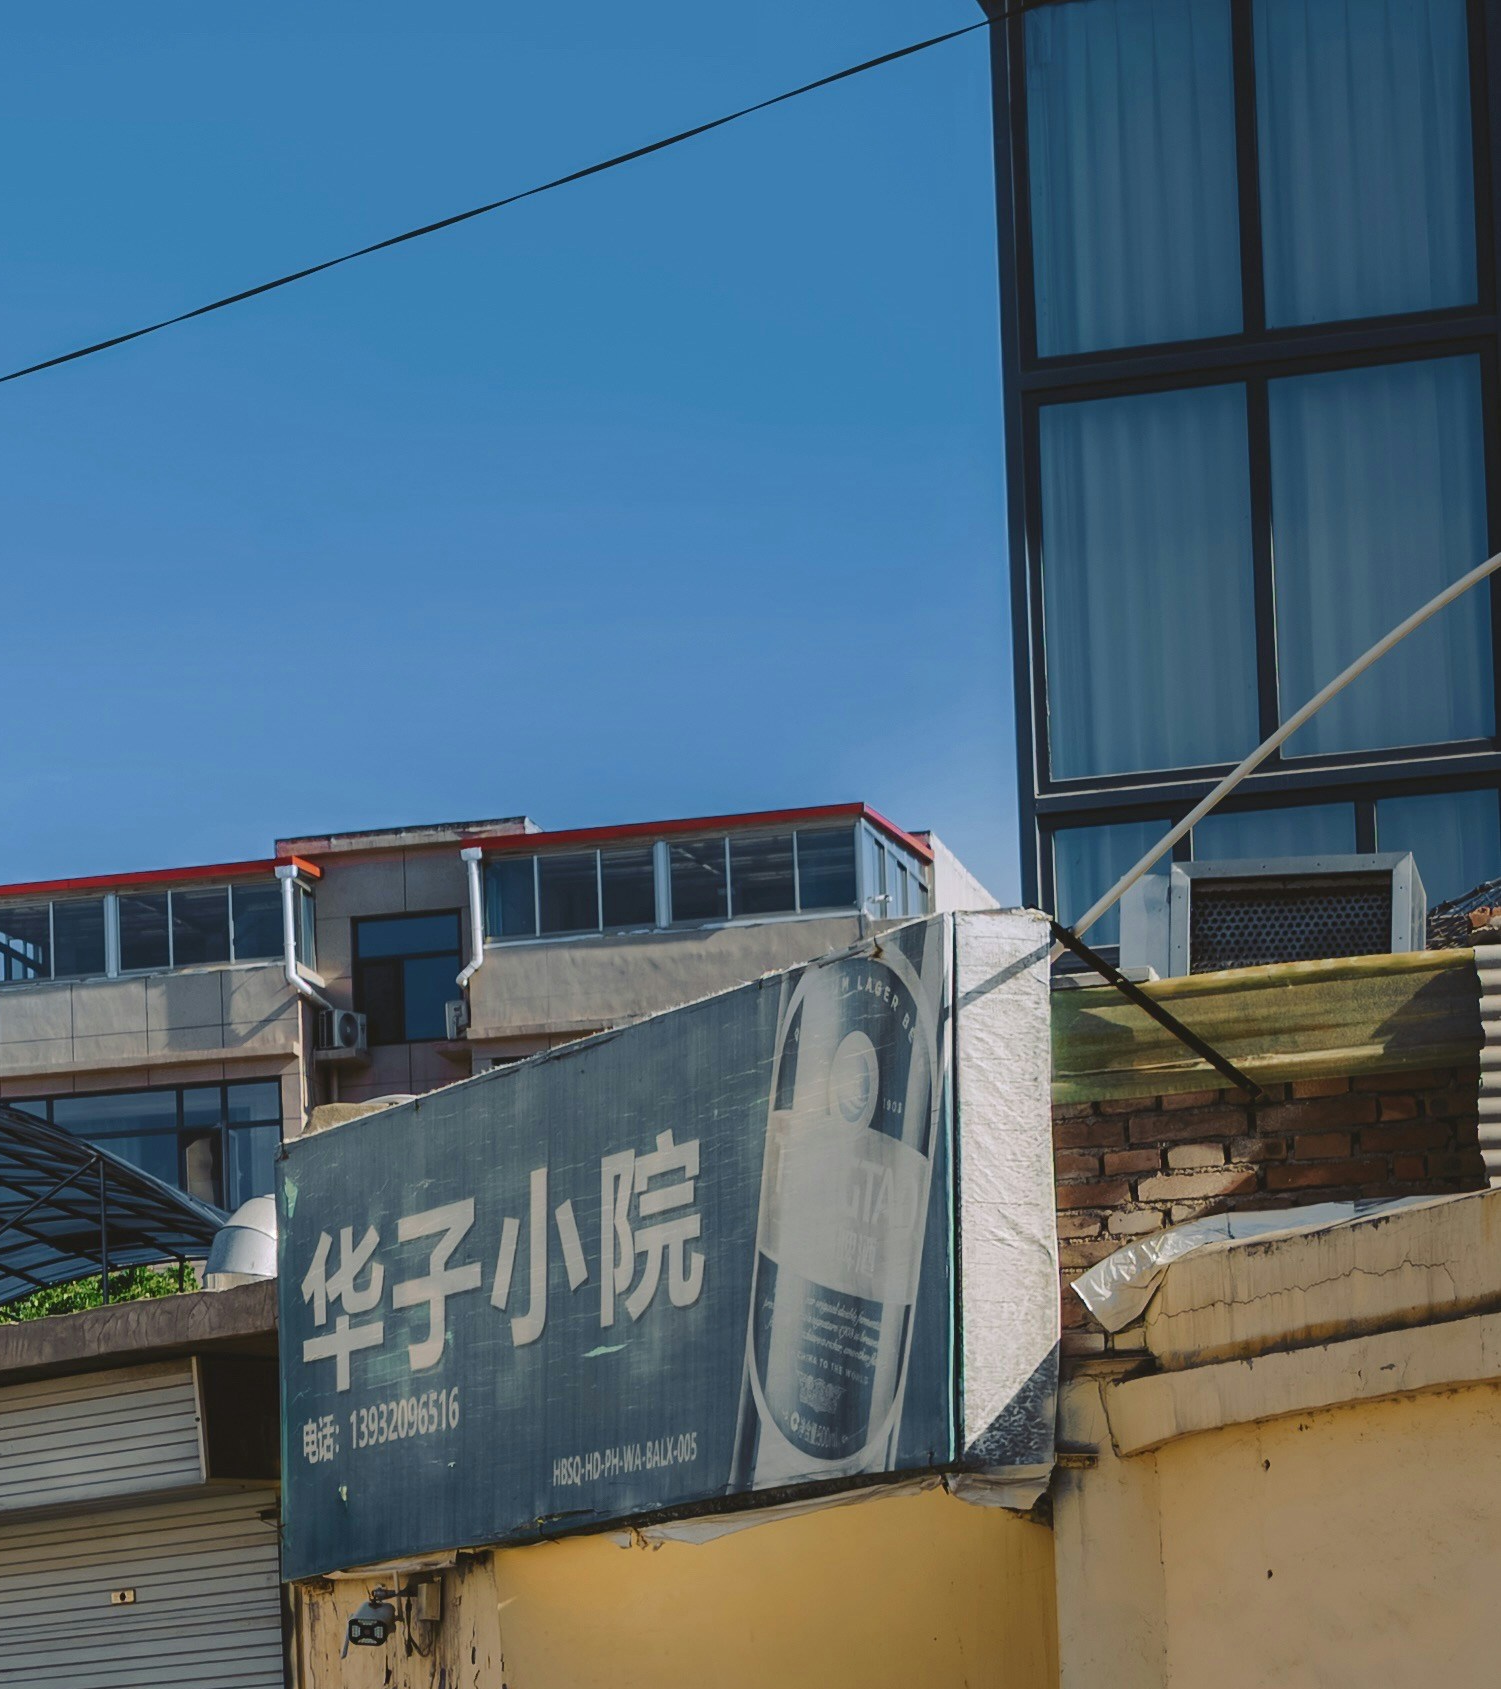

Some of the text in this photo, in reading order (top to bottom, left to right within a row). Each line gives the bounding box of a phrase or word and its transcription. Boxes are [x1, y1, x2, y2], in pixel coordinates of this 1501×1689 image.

[857, 976, 900, 1011] LAGER
[301, 1129, 705, 1392] 华子小院
[830, 1363, 844, 1375] THE
[350, 1387, 460, 1449] 13932096516
[553, 1431, 698, 1486] HBSQ-HD-PH-WA-BALX-005
